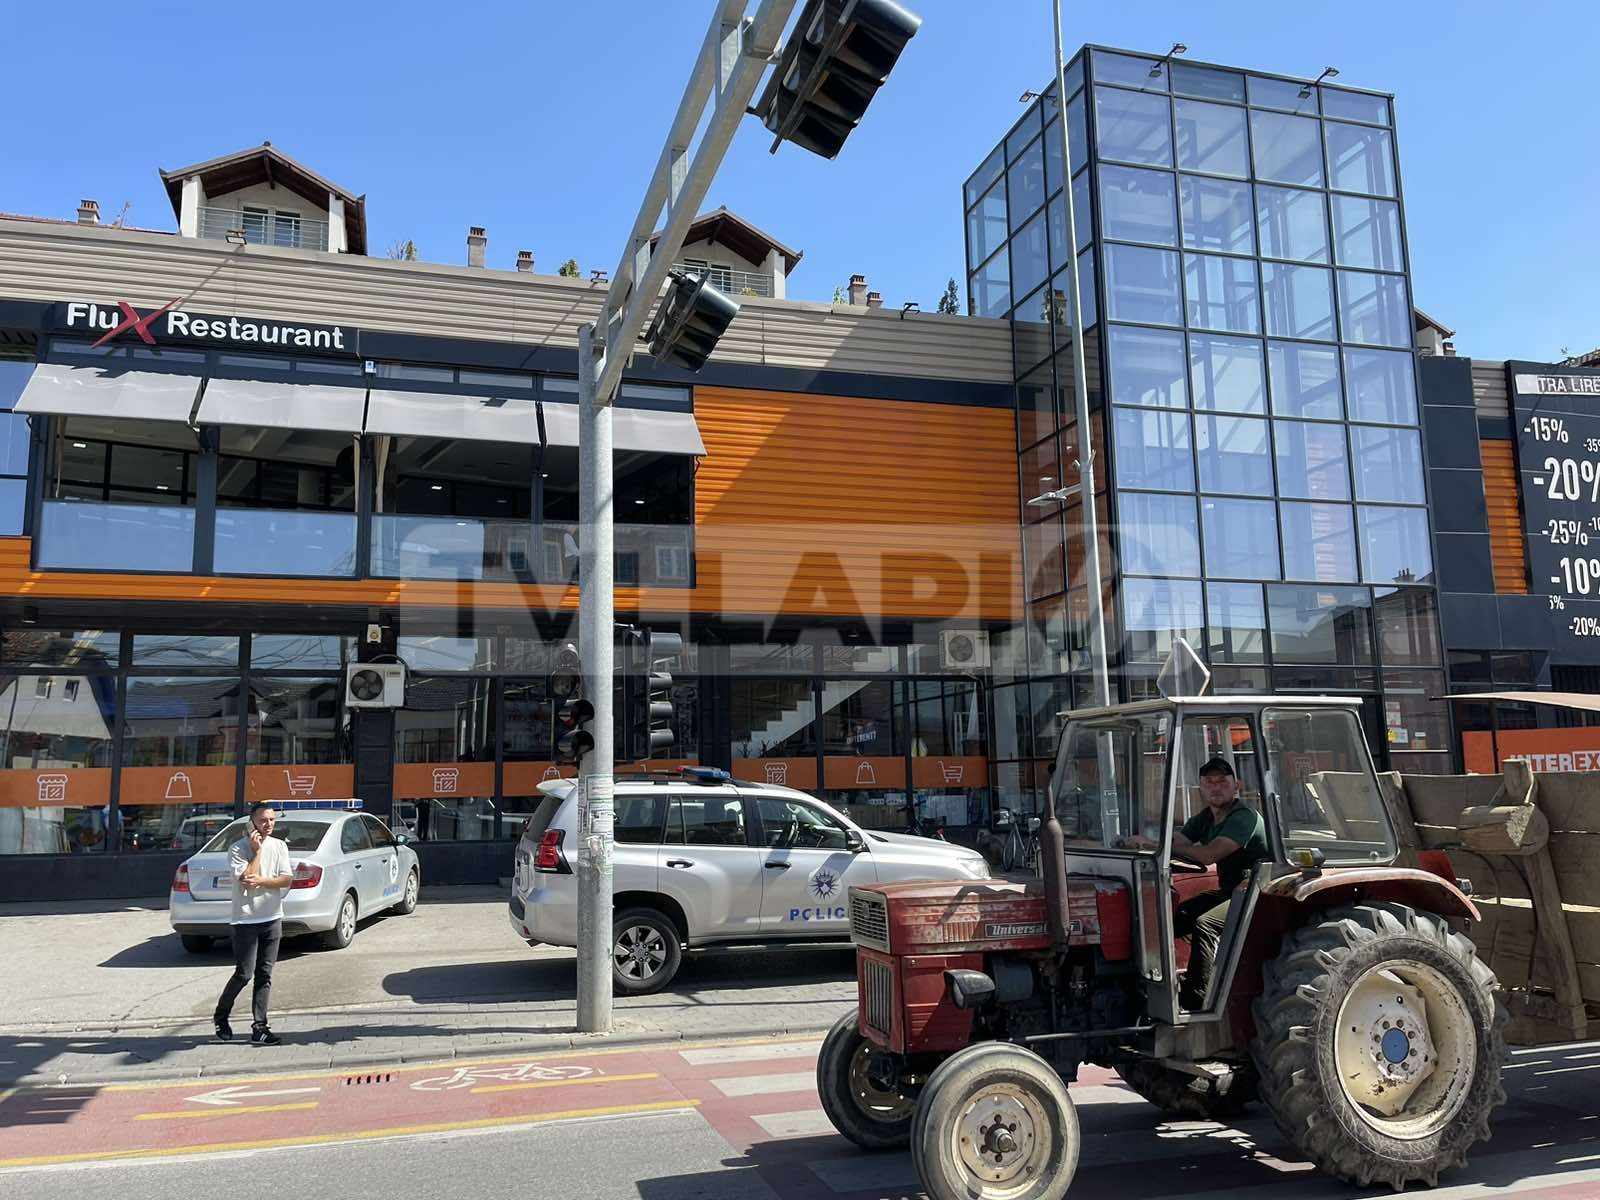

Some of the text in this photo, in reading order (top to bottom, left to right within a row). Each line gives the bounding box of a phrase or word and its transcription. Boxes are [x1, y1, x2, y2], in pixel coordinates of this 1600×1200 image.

[167, 311, 344, 349] Restaurant
[1524, 417, 1568, 443] -15%
[1542, 519, 1588, 545] -25%
[1569, 617, 1600, 636] -20%
[1510, 752, 1600, 773] TEREX
[789, 907, 846, 921] POLIC
